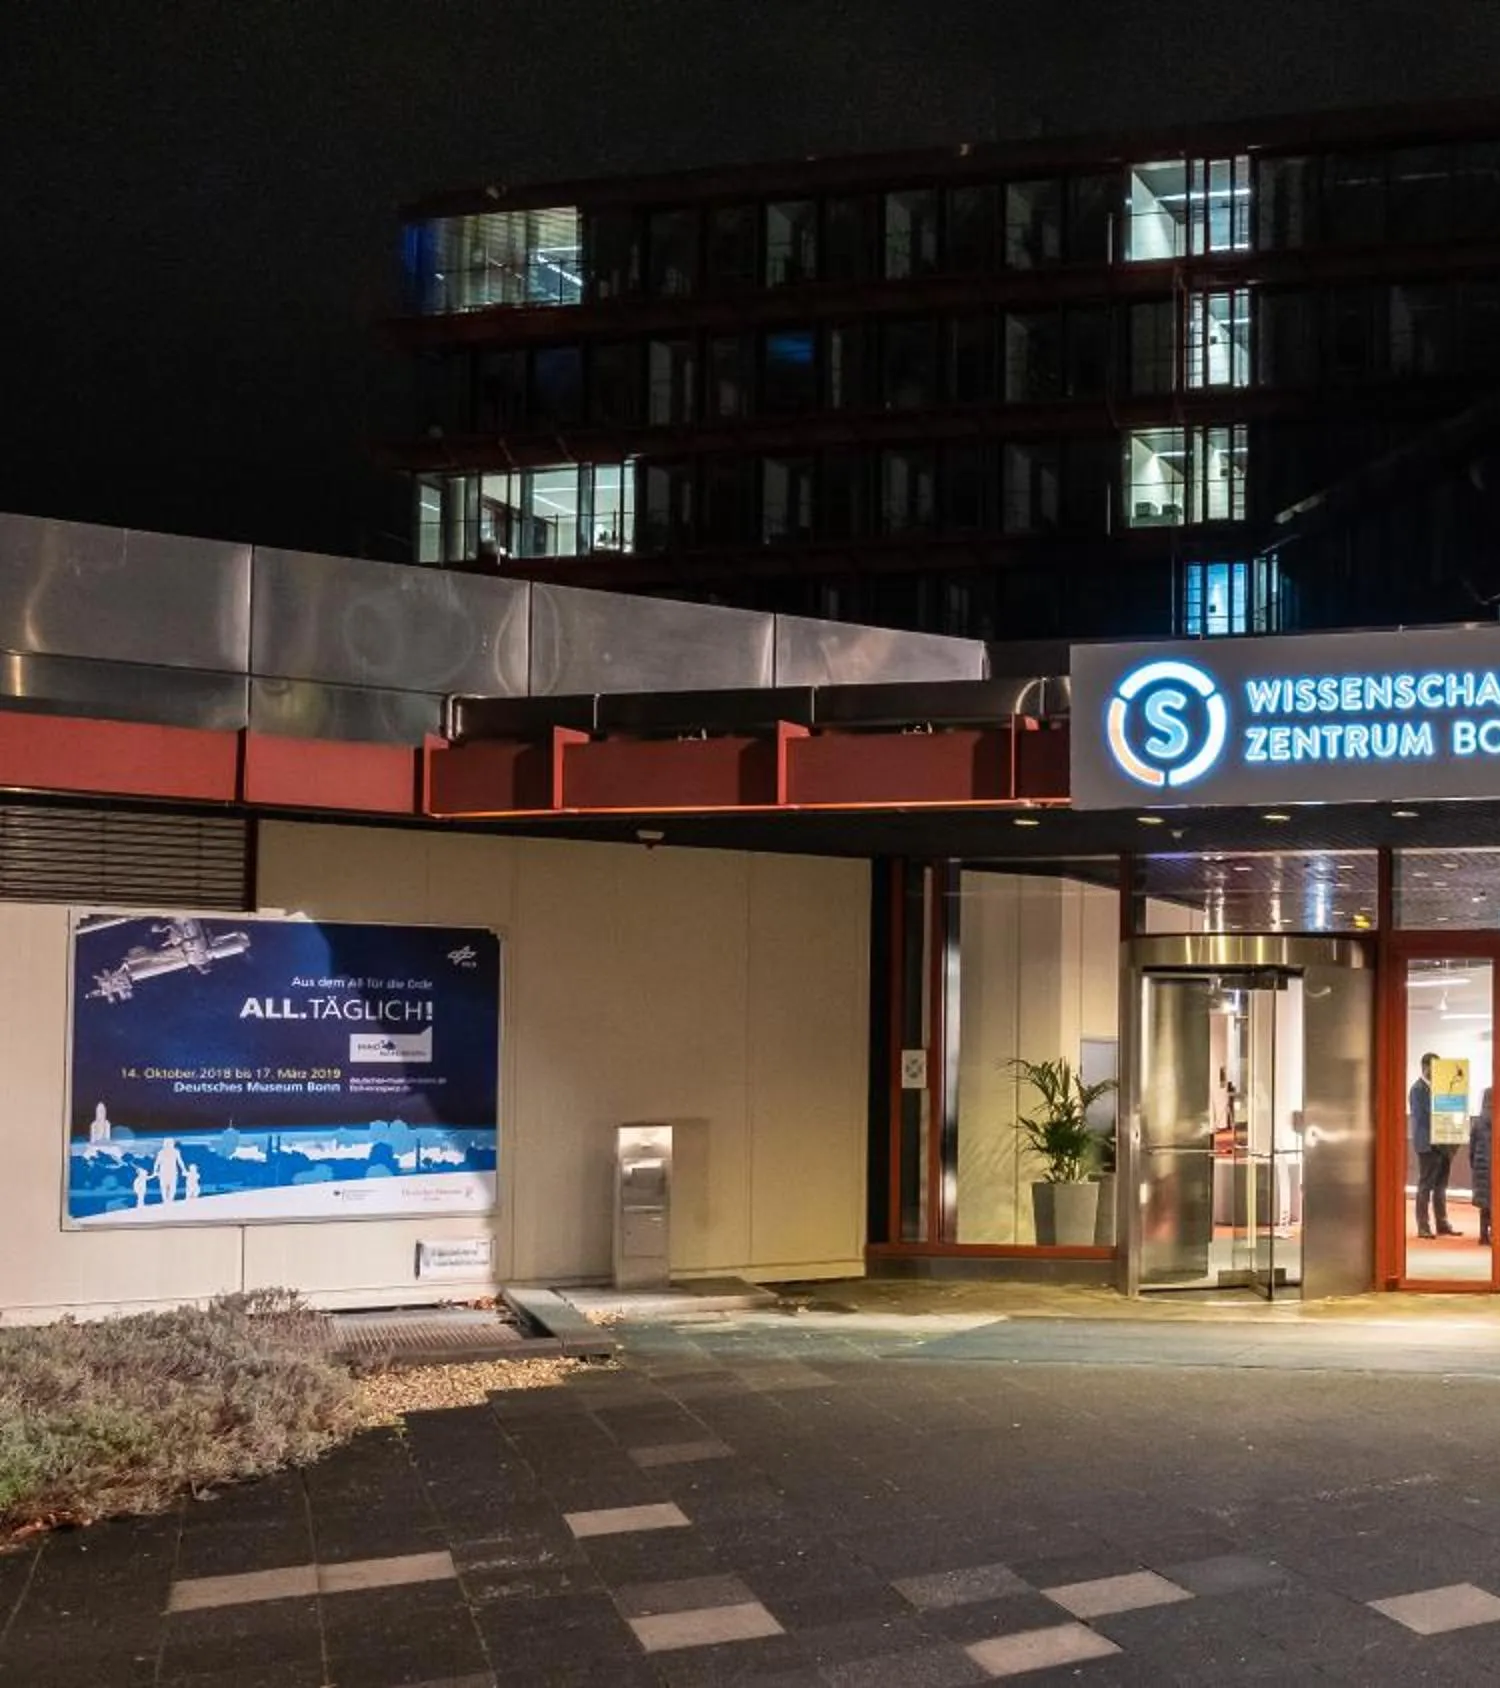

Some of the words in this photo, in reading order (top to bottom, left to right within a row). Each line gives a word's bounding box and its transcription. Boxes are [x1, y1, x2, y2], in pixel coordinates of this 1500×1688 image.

[1245, 725, 1433, 762] ZENTRUM
[291, 976, 315, 988] Aus
[317, 976, 345, 989] dem
[239, 995, 433, 1021] ALL.TÄGLICH!
[144, 1066, 196, 1079] Oktober
[200, 1067, 231, 1079] 2018
[235, 1067, 252, 1079] bis
[310, 1067, 341, 1079] 2019
[173, 1080, 243, 1093] Deutsches
[247, 1080, 303, 1093] Museum
[307, 1080, 341, 1093] Bonn
